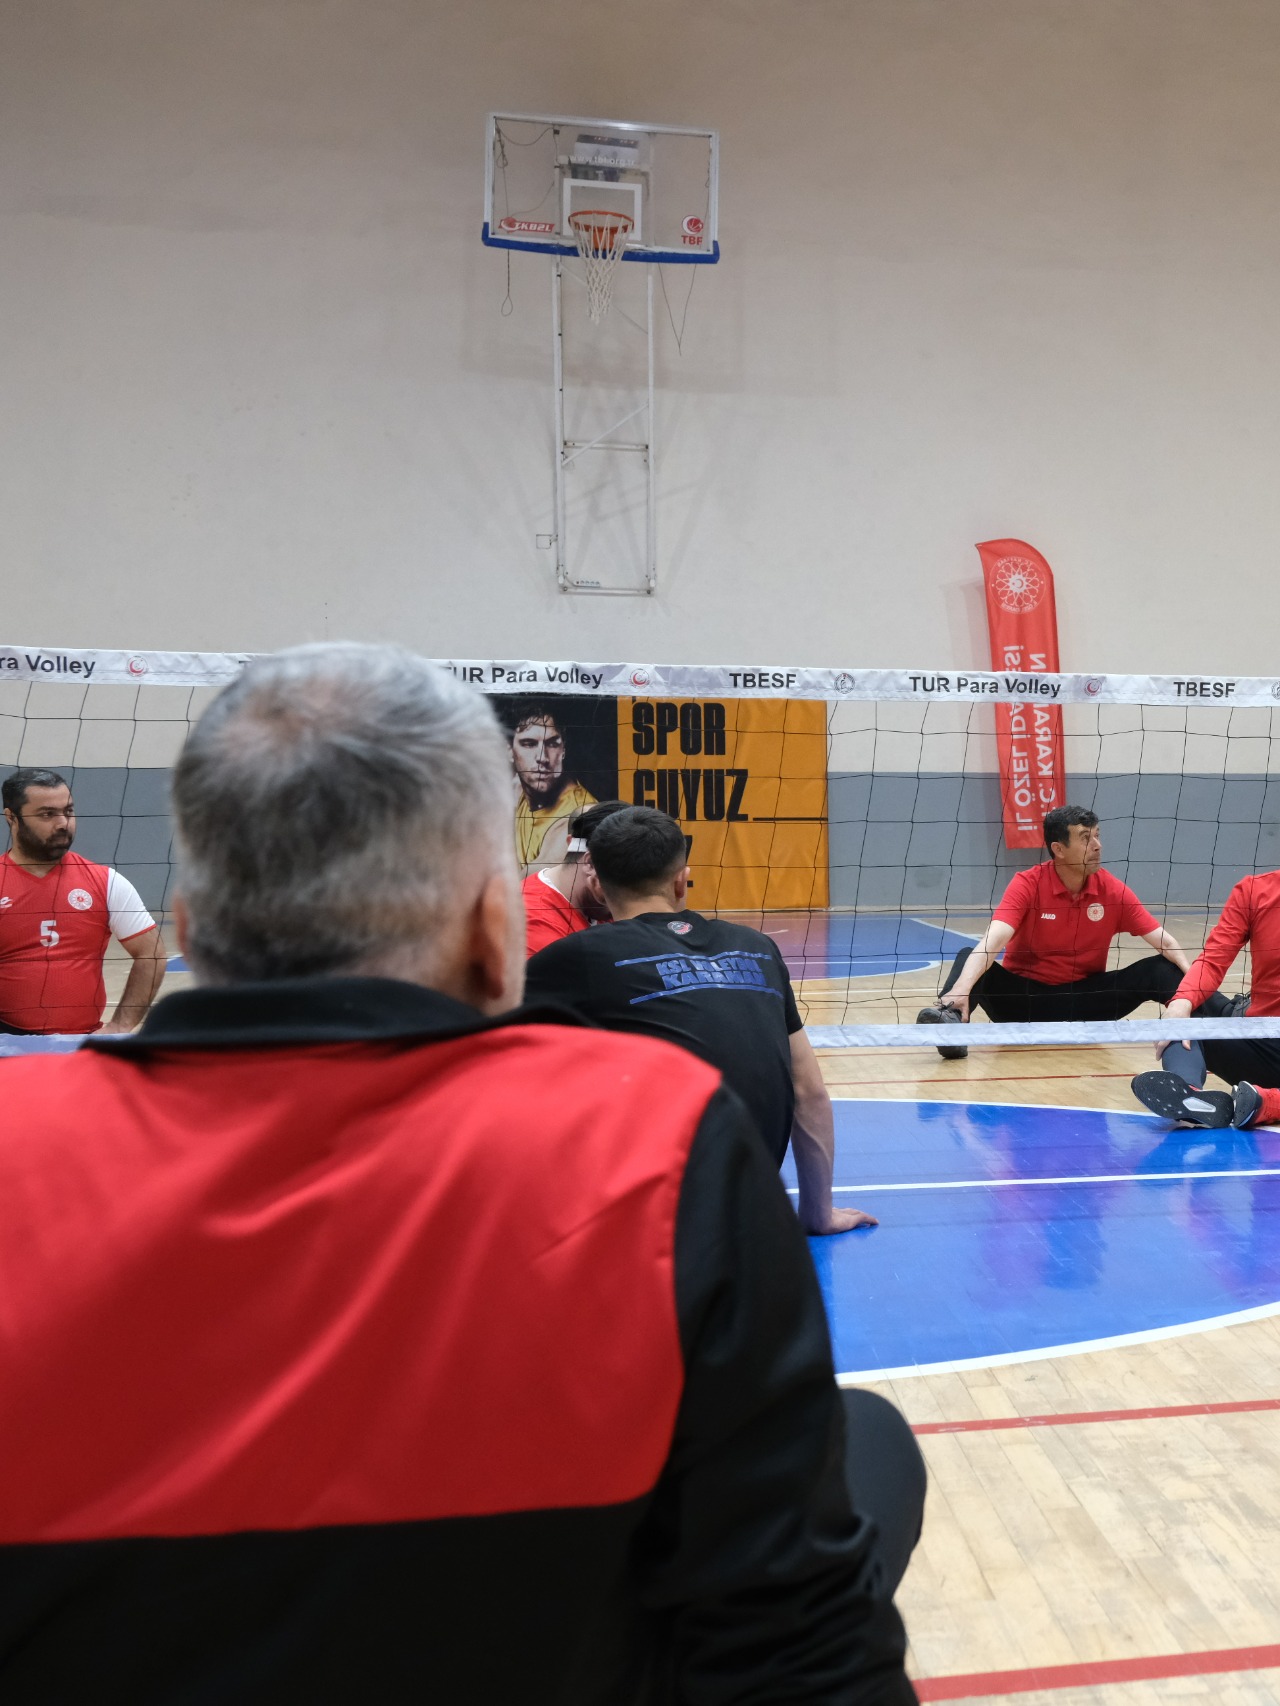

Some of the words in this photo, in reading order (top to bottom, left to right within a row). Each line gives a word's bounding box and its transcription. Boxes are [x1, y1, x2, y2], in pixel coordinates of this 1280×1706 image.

[681, 235, 703, 245] TBF
[0, 657, 19, 670] ra
[25, 654, 96, 679] Volley
[492, 667, 537, 683] Para
[545, 667, 603, 689] Volley
[729, 672, 796, 689] TBESF
[908, 676, 951, 693] TUR
[957, 677, 999, 694] Para
[1005, 677, 1061, 699] Volley
[1173, 681, 1236, 698] TBESF
[631, 702, 726, 756] SPOR
[632, 769, 748, 822] CUYUZ
[39, 920, 60, 947] 5
[656, 960, 692, 977] KSL
